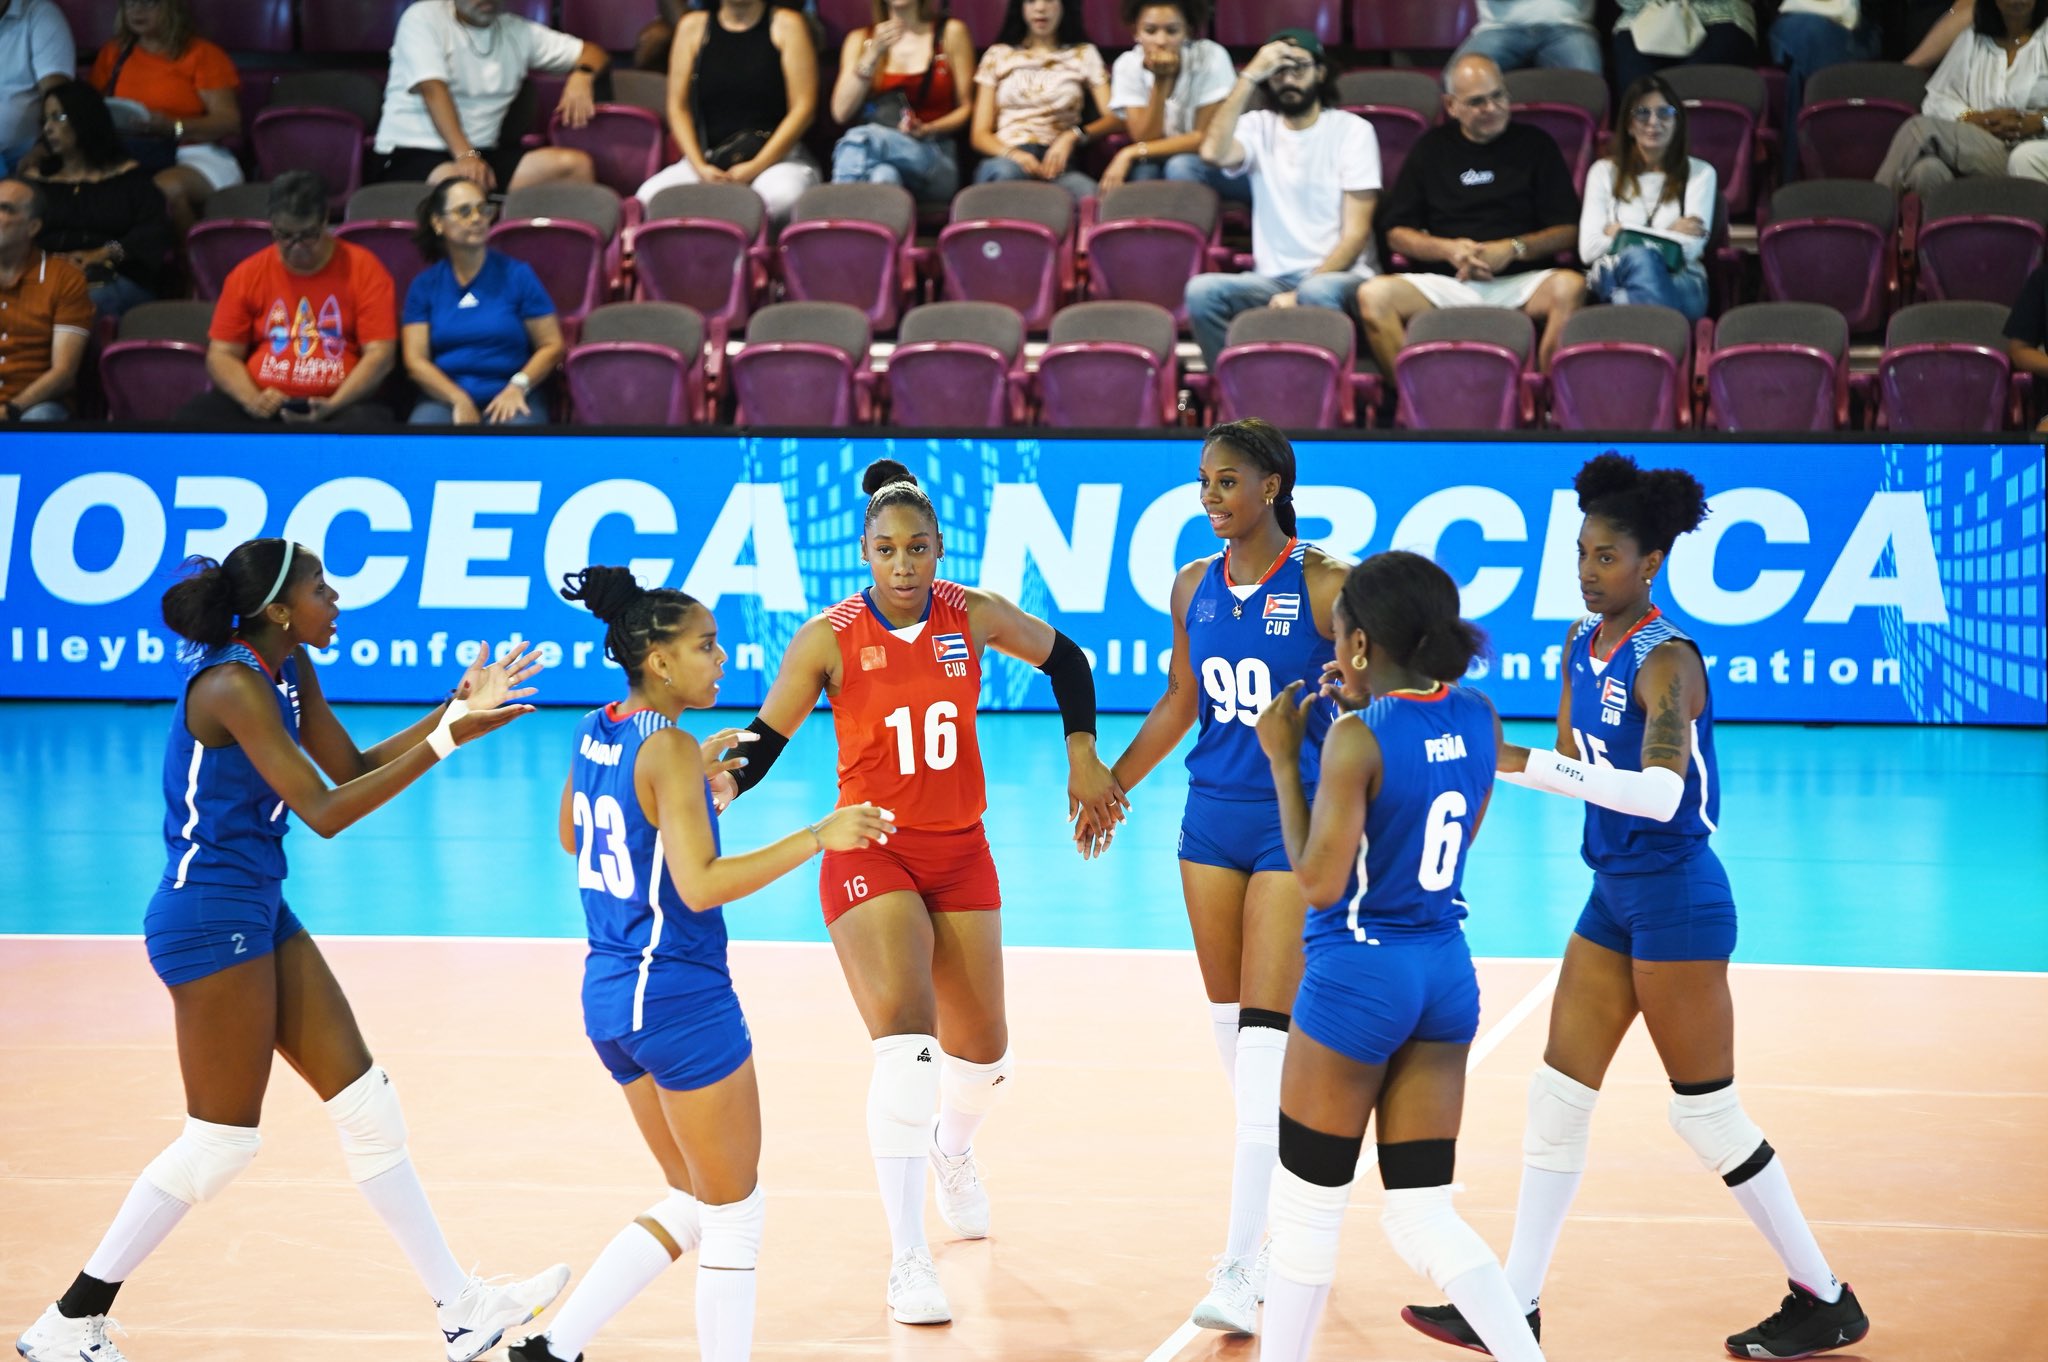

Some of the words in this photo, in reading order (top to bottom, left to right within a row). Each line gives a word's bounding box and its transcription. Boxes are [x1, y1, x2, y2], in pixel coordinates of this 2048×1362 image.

[0, 471, 808, 613] ORCECA
[1265, 620, 1291, 636] CUB
[944, 662, 967, 677] CUB
[1201, 656, 1272, 727] 99
[1601, 707, 1621, 726] CUB
[884, 700, 958, 775] 16
[1424, 733, 1467, 763] PEÑA
[1555, 763, 1584, 782] KIPSTA
[573, 791, 635, 899] 23
[1418, 791, 1467, 892] 6
[843, 875, 869, 902] 16
[231, 933, 248, 954] 2
[917, 1055, 932, 1063] PEAK
